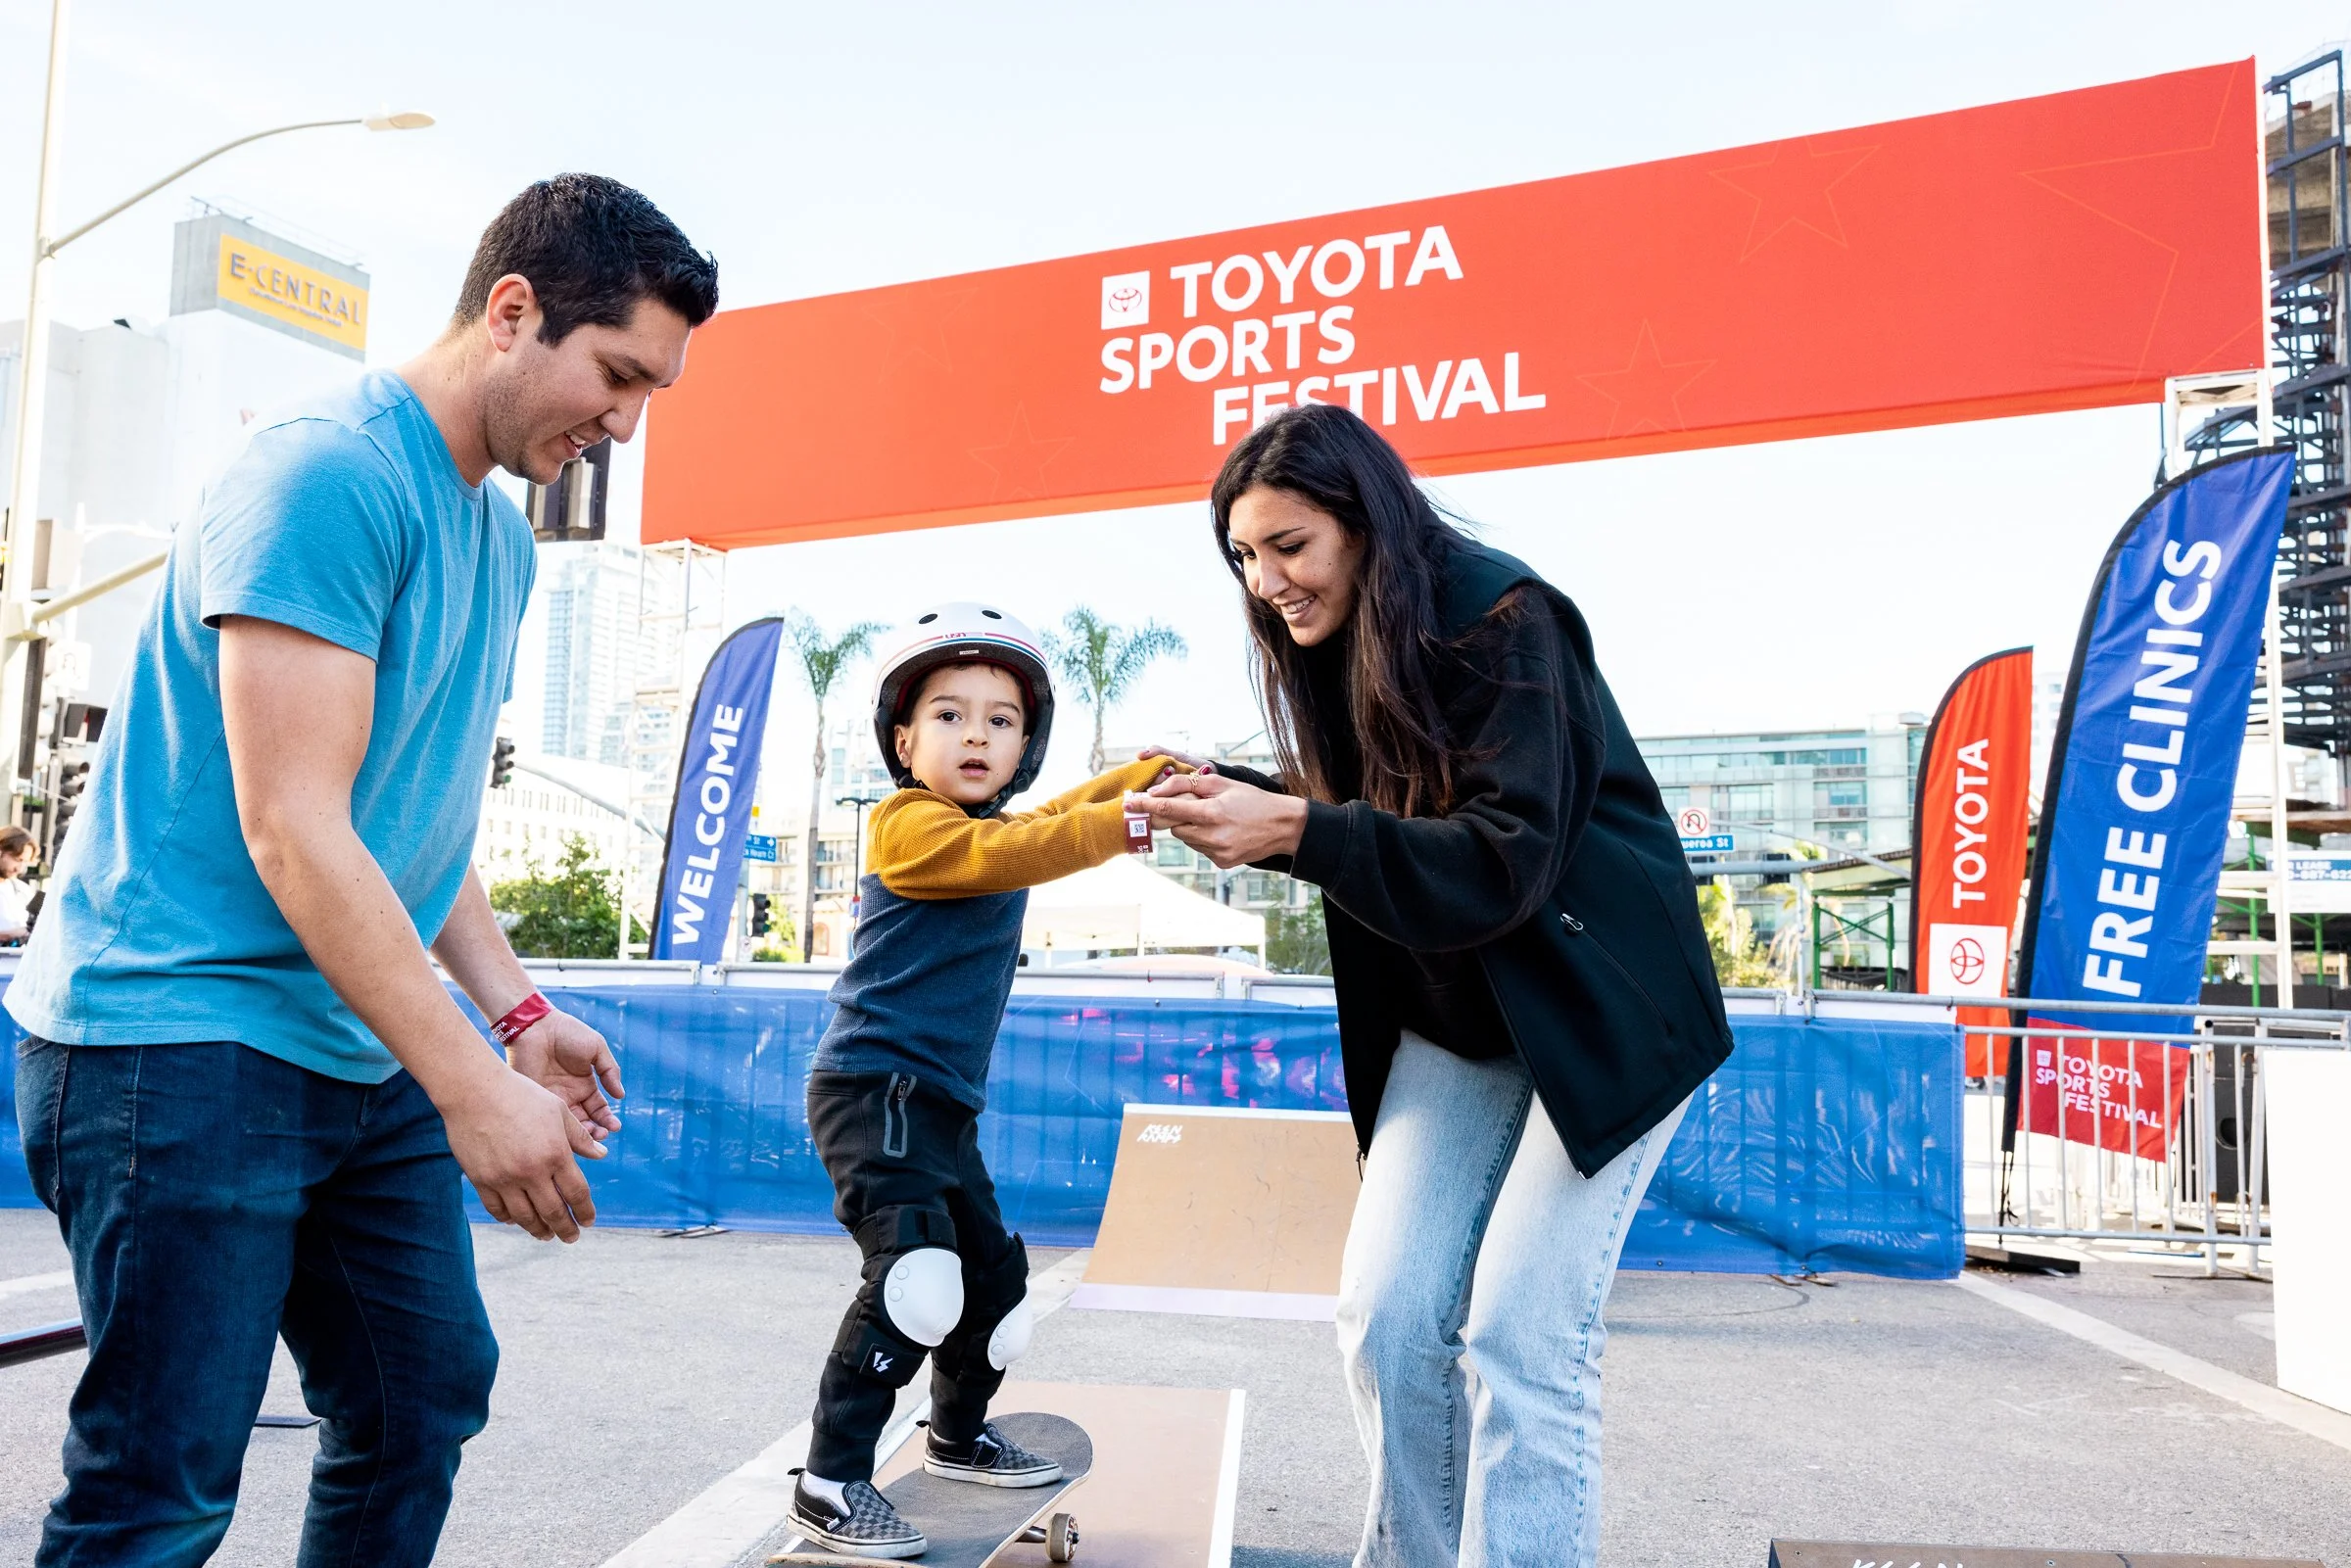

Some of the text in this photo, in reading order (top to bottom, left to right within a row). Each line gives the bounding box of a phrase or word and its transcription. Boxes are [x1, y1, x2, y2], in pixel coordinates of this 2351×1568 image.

[1170, 225, 1463, 319] TOYOTA
[1099, 306, 1357, 394] SPORTS
[2083, 539, 2222, 998] FREE CLINICS
[672, 703, 744, 945] WELCOME
[1680, 836, 1729, 849] ueroa St
[1952, 737, 1990, 909] TOYOTA
[499, 1025, 520, 1043] ESTIVAL
[2035, 1067, 2111, 1098] SPORTS
